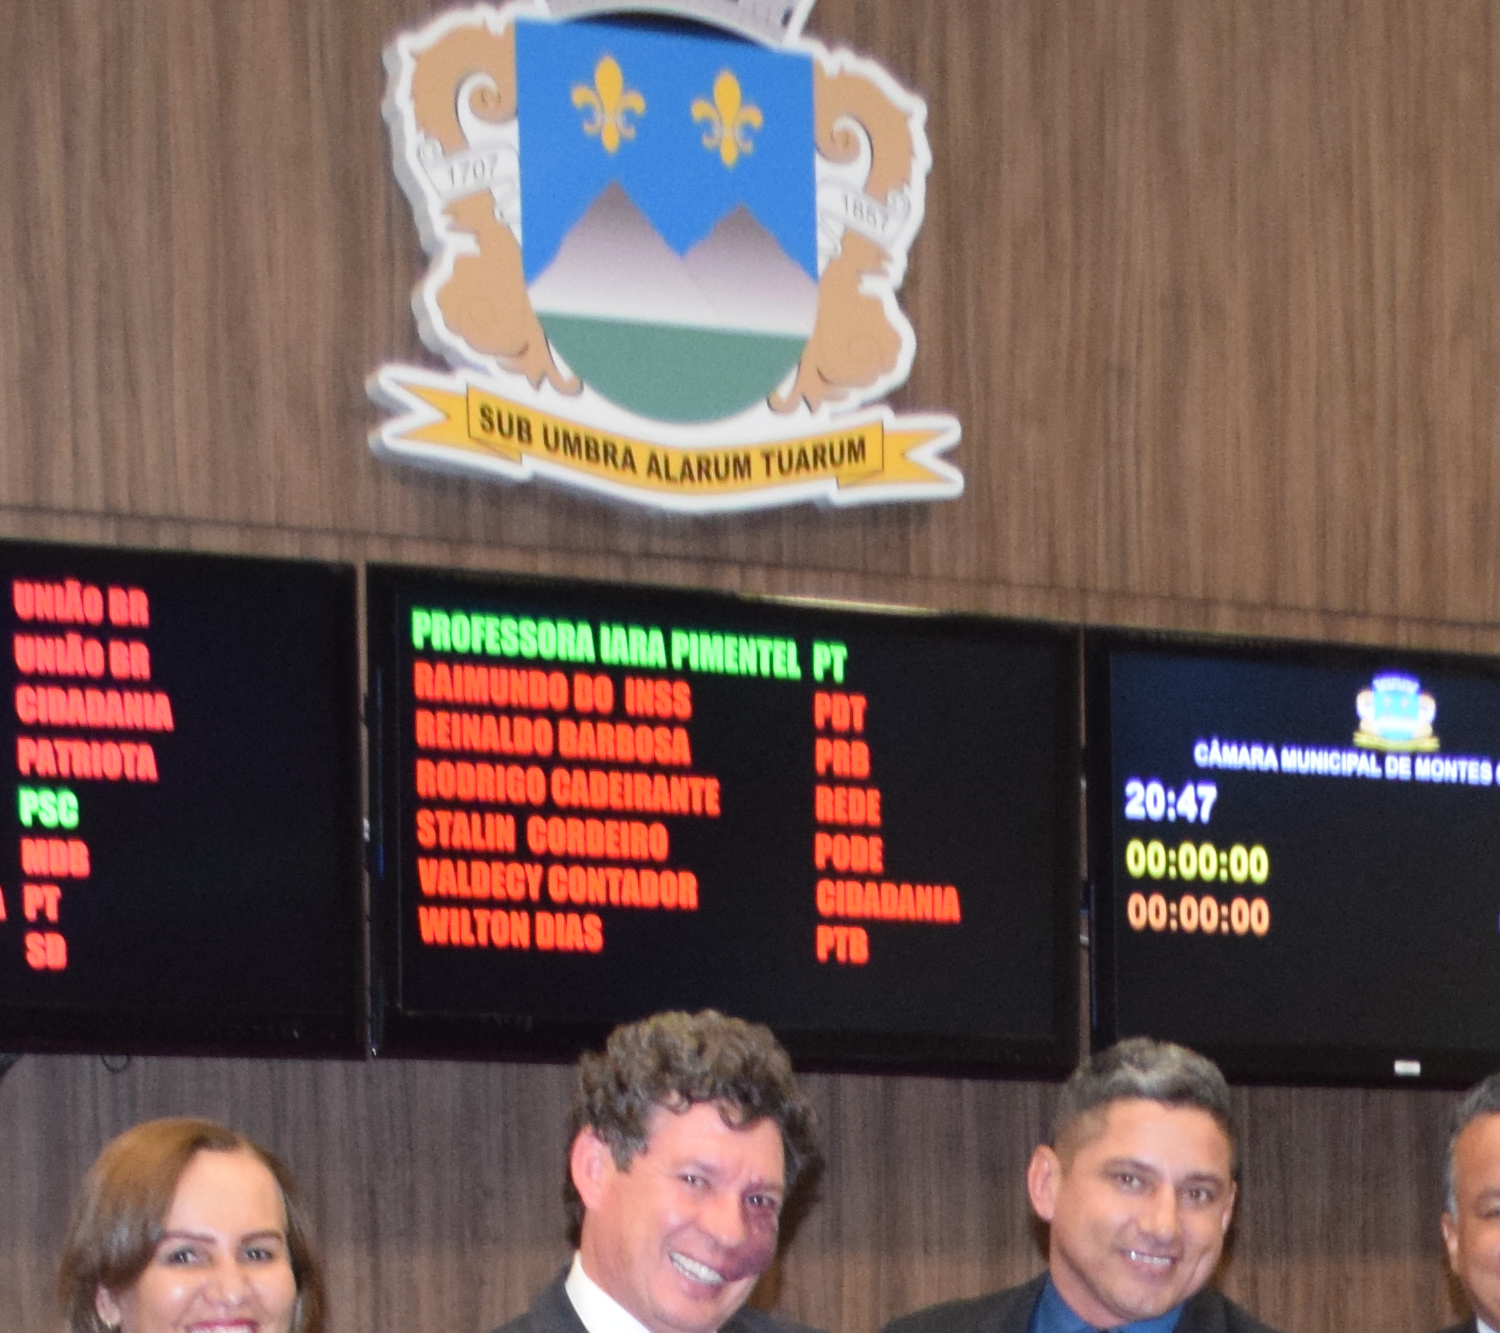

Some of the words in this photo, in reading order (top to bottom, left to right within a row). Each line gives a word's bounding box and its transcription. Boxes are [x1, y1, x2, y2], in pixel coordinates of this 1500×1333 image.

[449, 152, 498, 187] 1707
[478, 404, 532, 444] SUB
[543, 425, 637, 473] UMBRA
[646, 450, 752, 485] ALARUM
[761, 435, 866, 477] TUARUM
[15, 577, 104, 625] UNIÃO
[109, 585, 149, 629] BR
[15, 631, 104, 677] UNIÃO
[110, 640, 150, 682] BR
[412, 608, 594, 663] PROFESSORA
[600, 621, 667, 670] IARA
[672, 627, 801, 681] PIMENTEL
[813, 641, 847, 684] PT
[16, 684, 174, 732] CIDADANIA
[414, 660, 569, 713] RAIMUNDO
[573, 673, 613, 715] DO
[625, 676, 692, 721] INSS
[814, 691, 866, 734] PDT
[18, 737, 159, 783] PATRIOTA
[415, 709, 553, 758] REINALDO
[558, 719, 691, 767] BARBOSA
[815, 738, 870, 780] PRB
[1193, 737, 1278, 773] CÂMARA
[1281, 745, 1381, 778] MUNICIPAL
[1385, 753, 1411, 780] DE
[1415, 755, 1492, 786] MONTES
[19, 787, 79, 829] PSC
[416, 760, 545, 805] RODRIGO
[551, 767, 720, 817] CADEIRANTE
[815, 785, 881, 829] REDE
[1125, 778, 1218, 824] 20:47
[22, 837, 90, 880] MDB
[417, 810, 516, 855] STALIN
[528, 815, 668, 863] CORDEIRO
[814, 833, 883, 875] PODE
[1126, 838, 1269, 884] 00:00:00
[23, 884, 61, 924] PT
[418, 858, 542, 903] VALDECY
[548, 865, 698, 912] CONTADOR
[816, 880, 961, 924] CIDADANIA
[419, 906, 530, 949] WILTON
[536, 913, 602, 953] DIAS
[1127, 891, 1270, 936] 00:00:00
[816, 925, 869, 966] PTB
